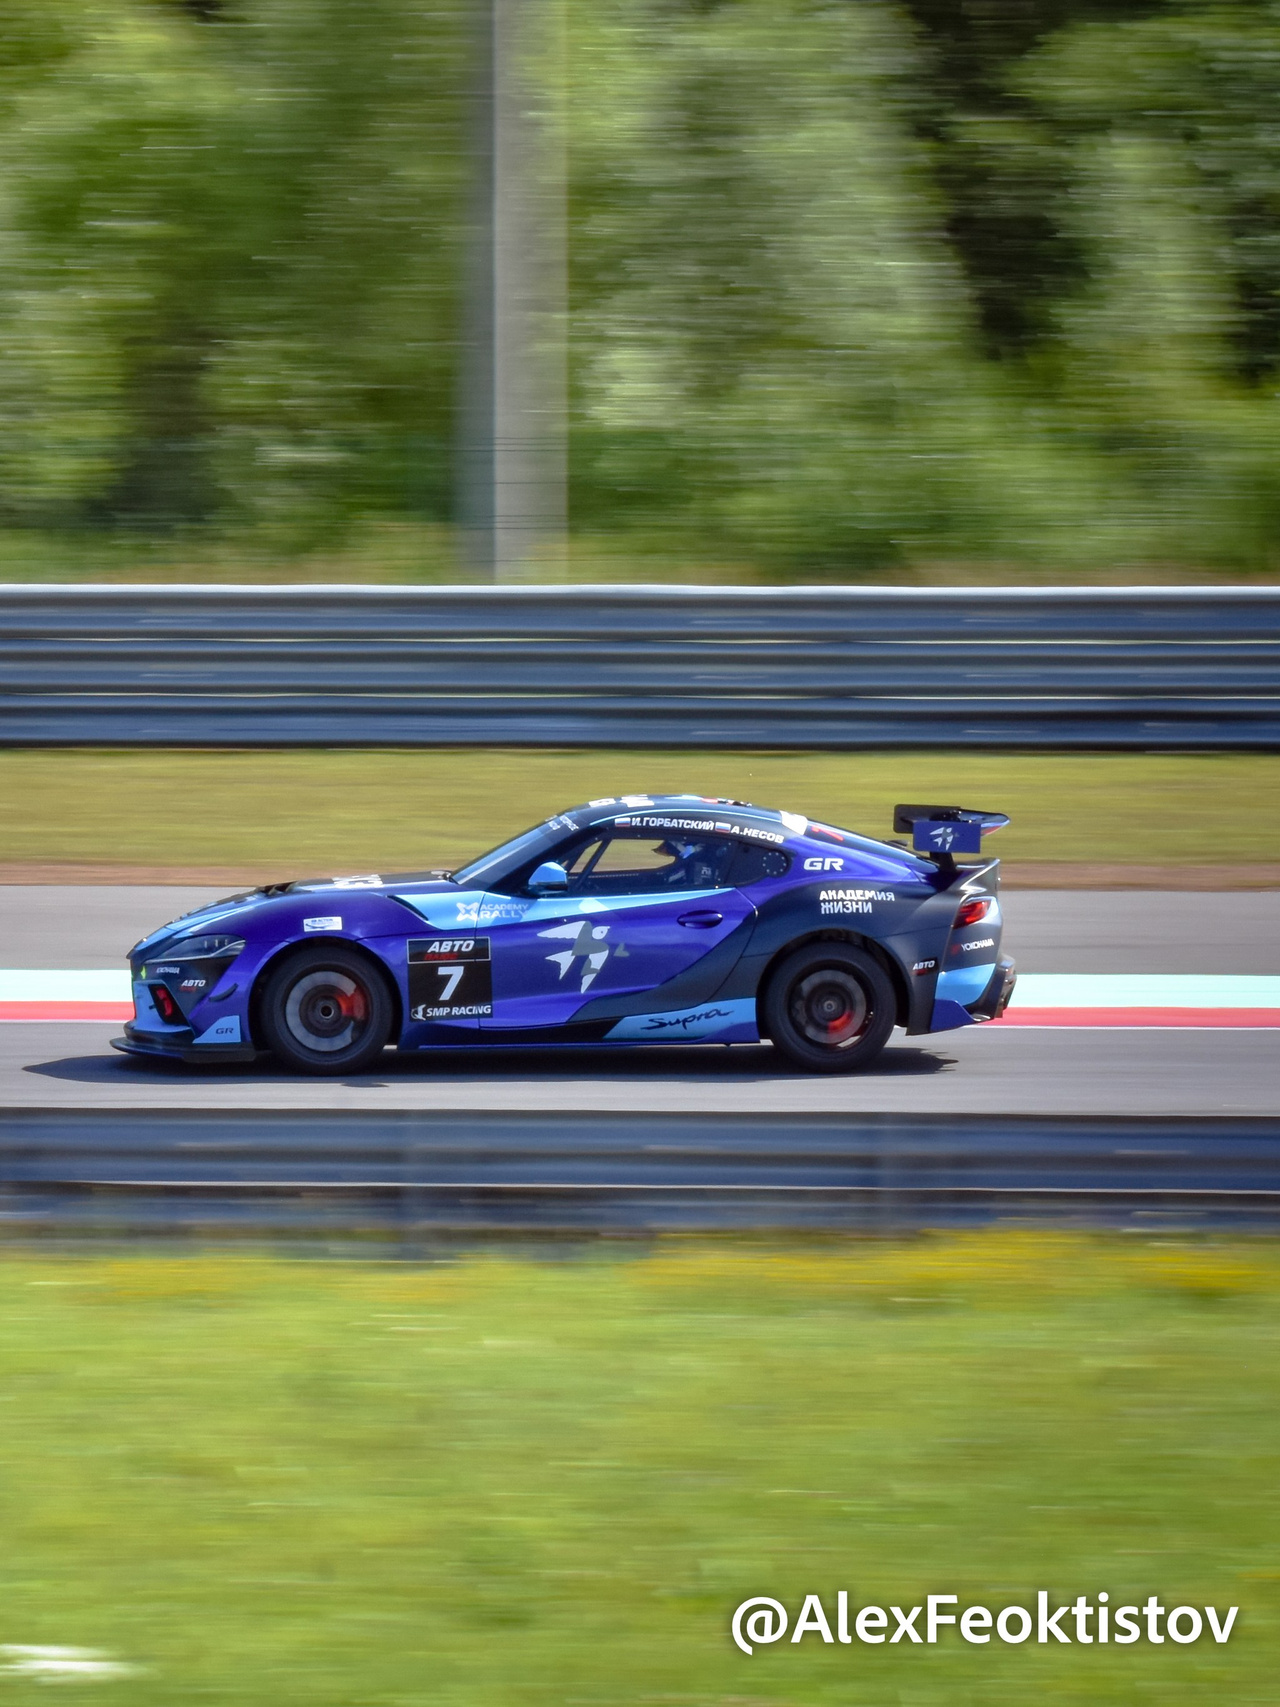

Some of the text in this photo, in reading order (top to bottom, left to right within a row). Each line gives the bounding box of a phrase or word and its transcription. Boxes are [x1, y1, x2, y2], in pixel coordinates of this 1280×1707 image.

[803, 857, 844, 871] GR
[819, 889, 895, 902] АКАДЕМИЯ
[480, 903, 528, 911] ACADEMY
[820, 901, 873, 914] ЖИЗНИ
[480, 910, 528, 918] RALLY
[427, 940, 475, 953] АВТО
[437, 966, 465, 1001] 7
[426, 1005, 492, 1017] SMP RACING
[640, 1008, 735, 1030] Supra
